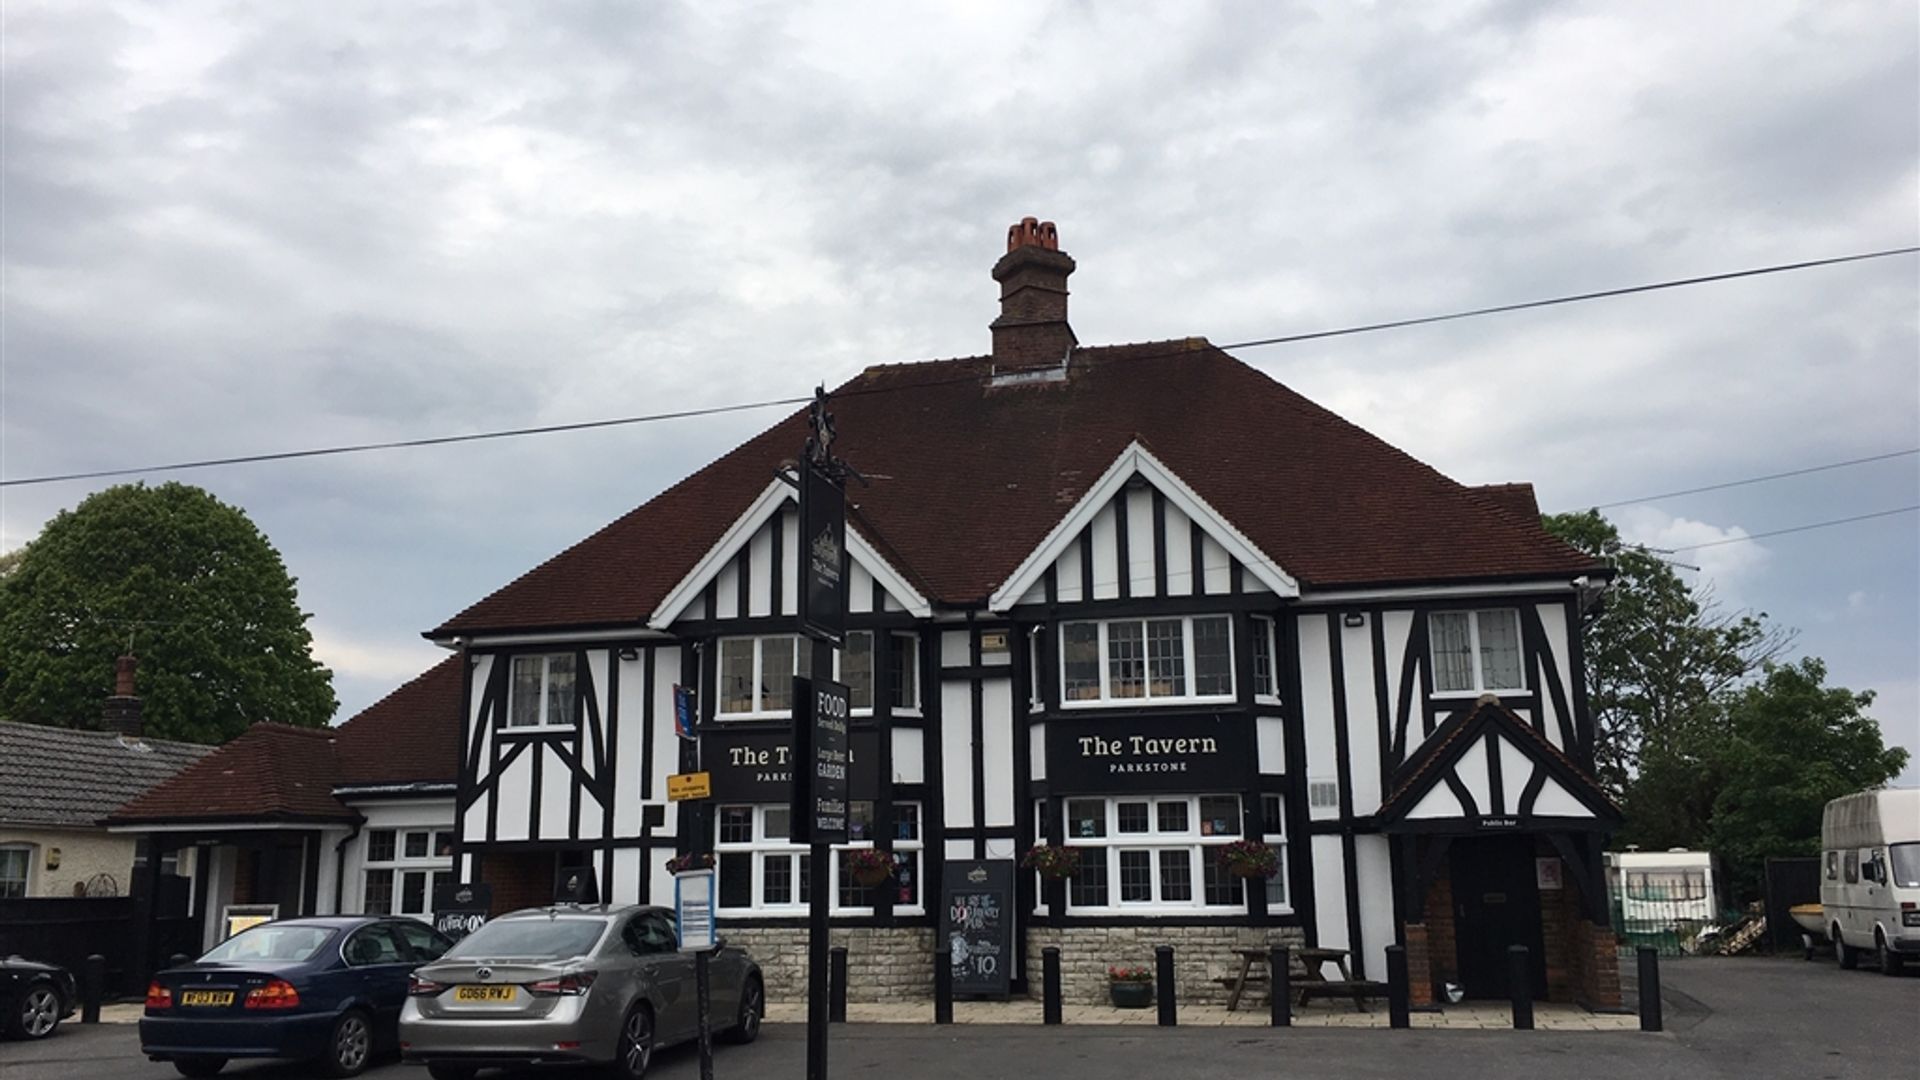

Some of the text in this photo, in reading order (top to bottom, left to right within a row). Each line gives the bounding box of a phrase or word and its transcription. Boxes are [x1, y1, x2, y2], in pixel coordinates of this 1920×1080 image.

[817, 691, 848, 718] FOOD
[1078, 736, 1217, 756] The Tavern
[729, 746, 769, 765] The
[817, 762, 845, 780] GARDEN
[1110, 762, 1187, 773] PARKSTONE
[817, 797, 845, 813] Families
[1482, 819, 1517, 827] Public Bar
